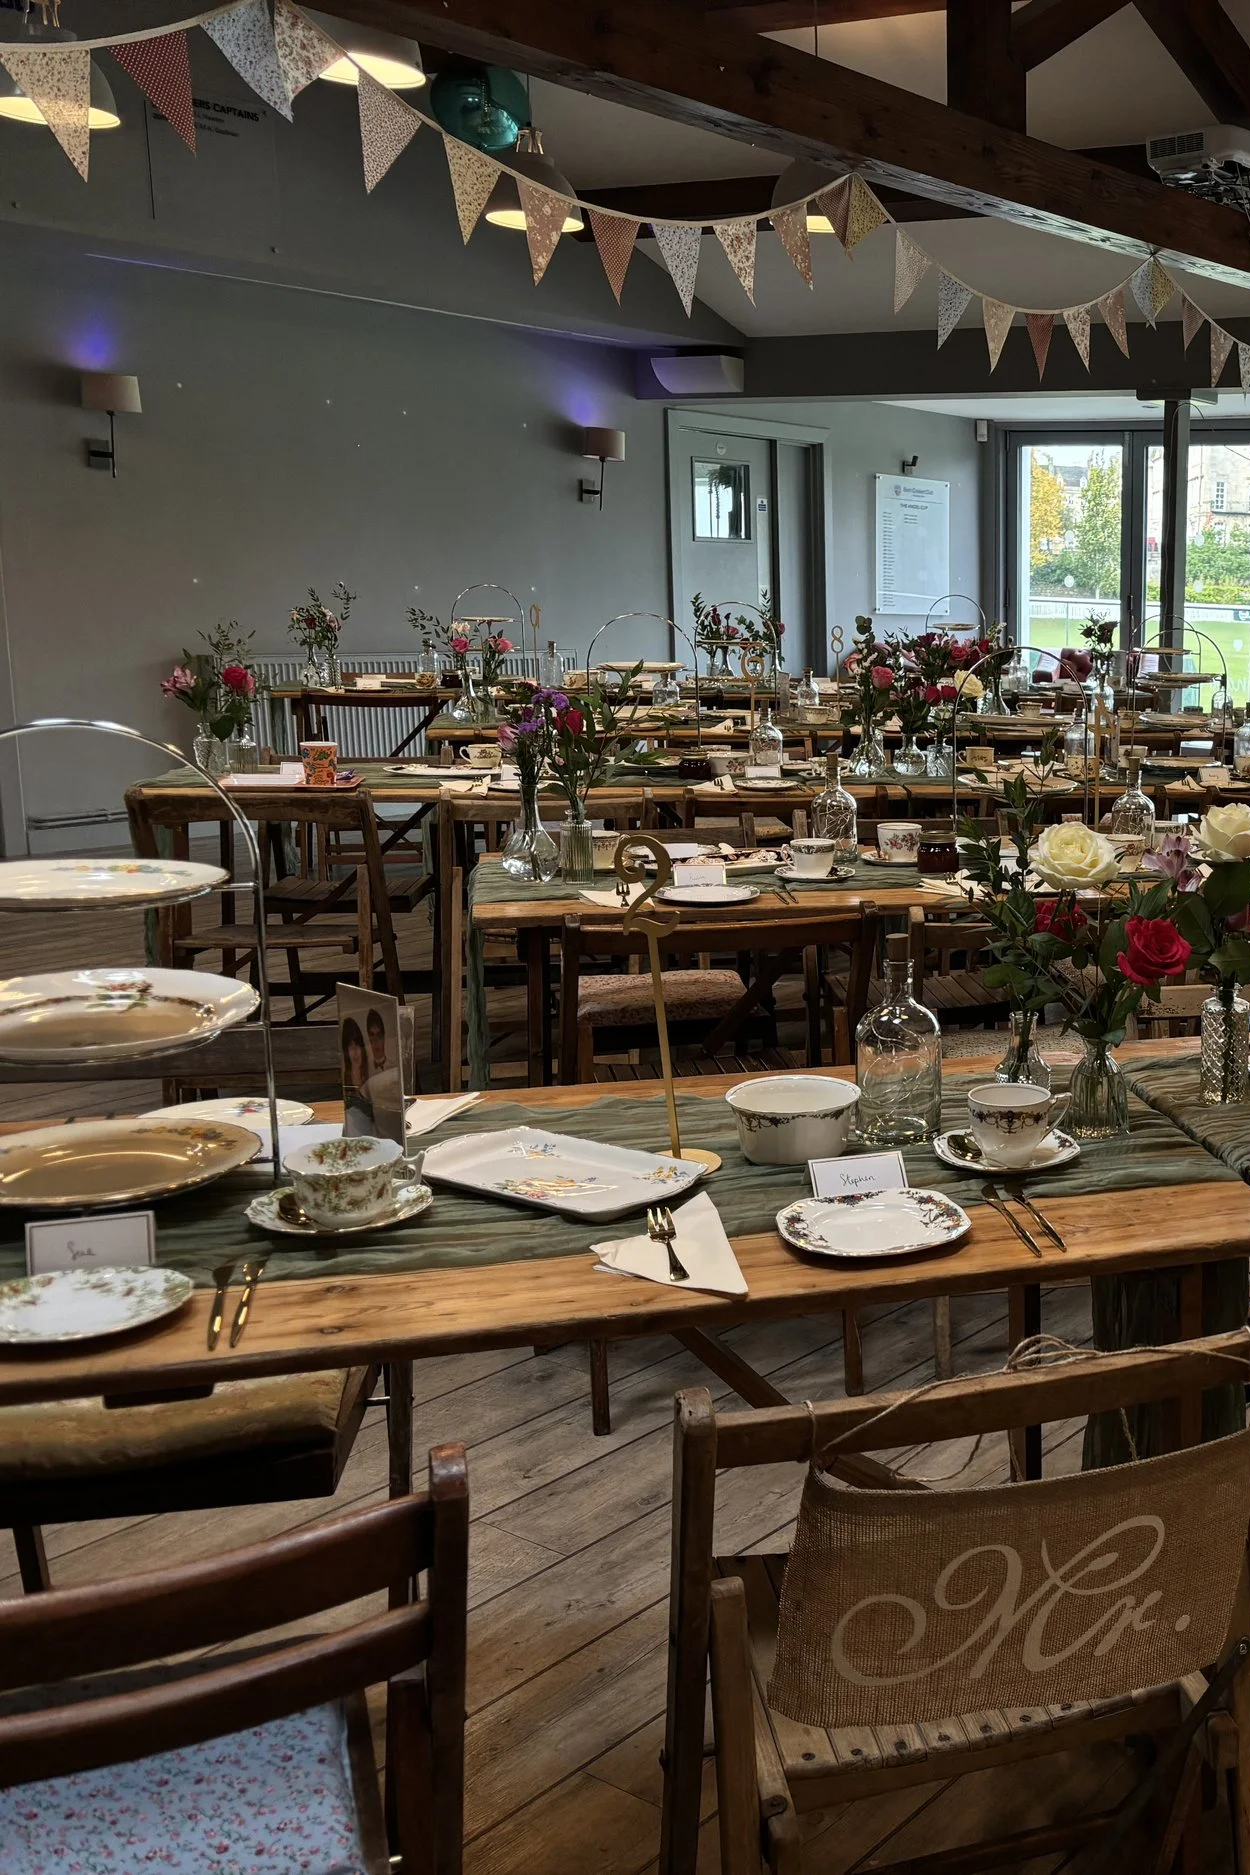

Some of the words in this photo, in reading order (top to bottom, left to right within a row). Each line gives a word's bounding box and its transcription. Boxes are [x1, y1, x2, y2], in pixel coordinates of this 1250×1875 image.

[213, 102, 260, 122] CAPTAINS
[831, 625, 844, 654] 8
[740, 641, 765, 682] 6
[614, 834, 681, 937] 2
[840, 1172, 876, 1188] Stephen
[831, 1514, 1191, 1687] Mr.
